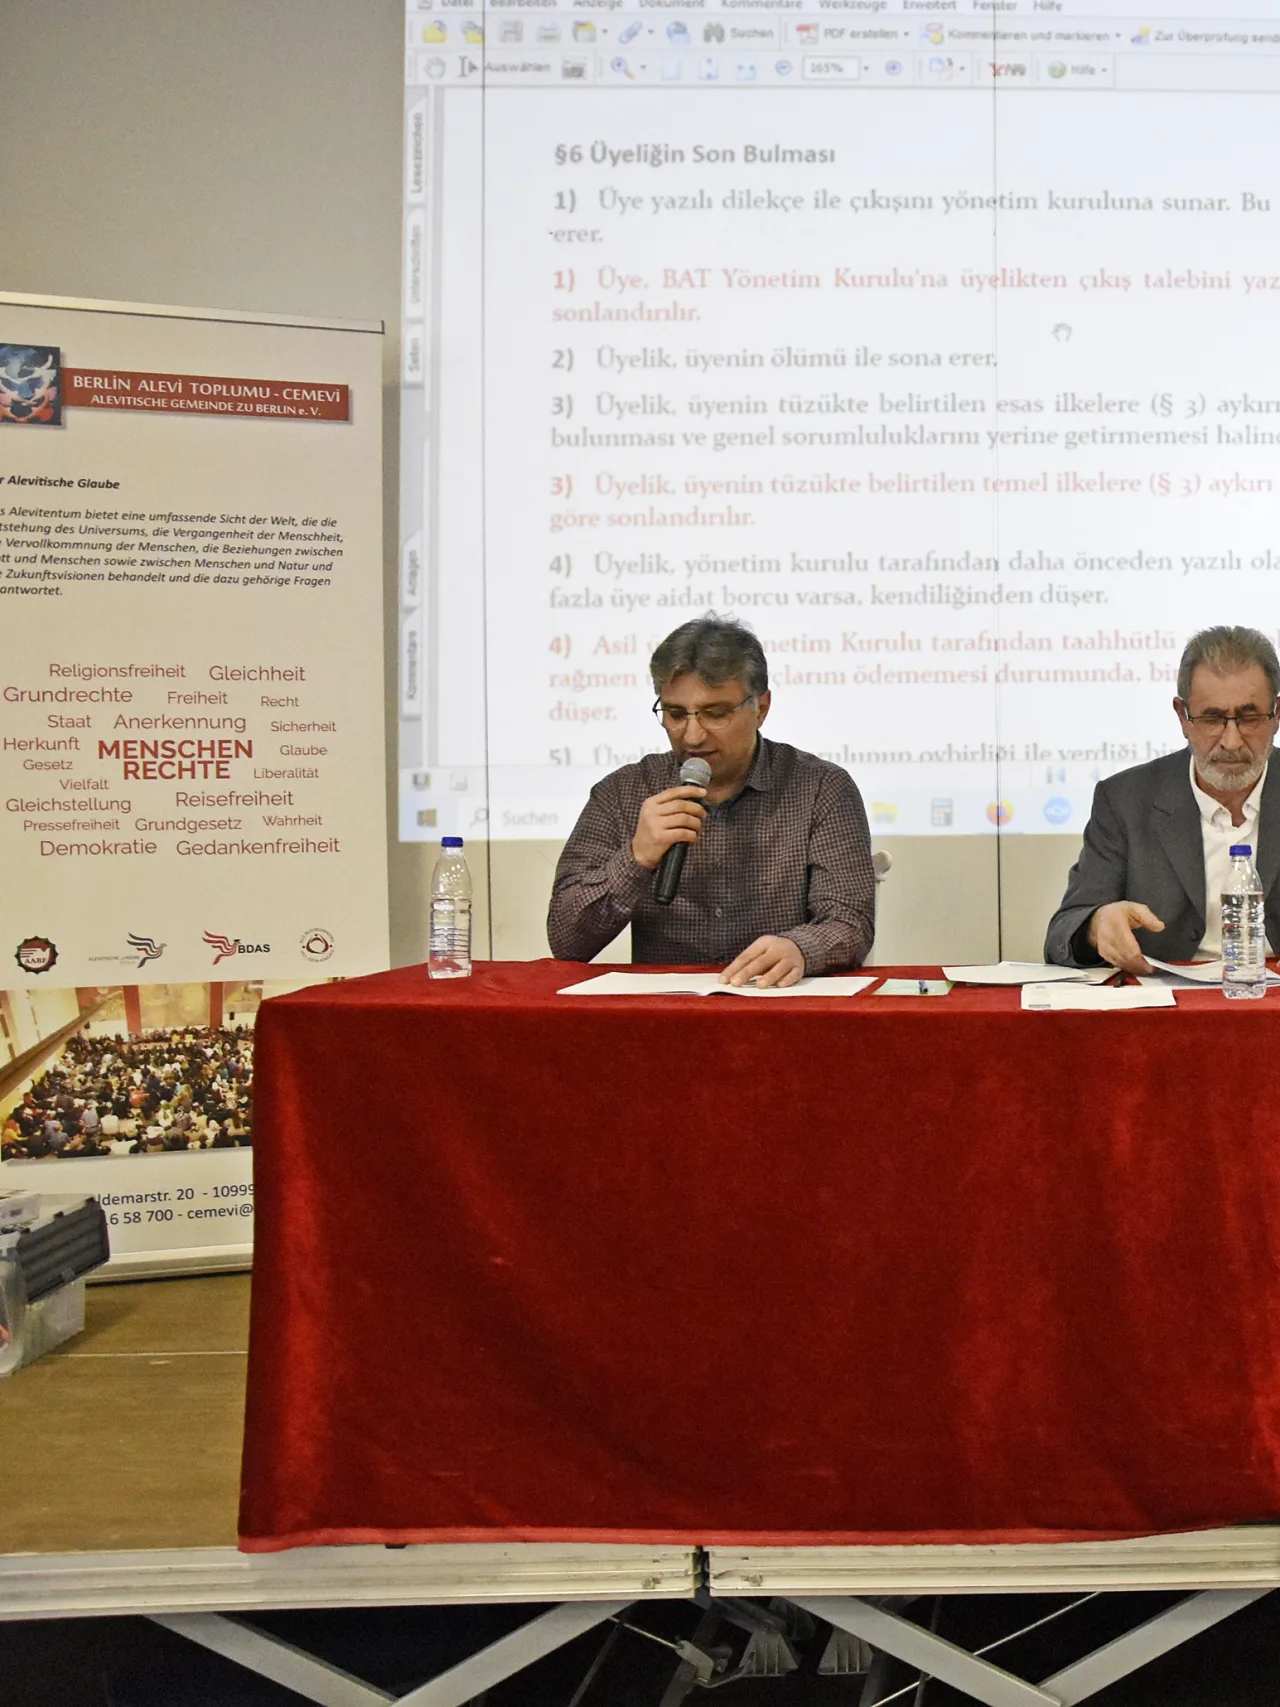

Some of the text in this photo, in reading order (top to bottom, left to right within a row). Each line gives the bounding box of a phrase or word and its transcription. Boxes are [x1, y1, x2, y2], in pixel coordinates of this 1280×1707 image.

[555, 140, 835, 168] §6 Üyeliğin Son Bulması
[554, 188, 577, 215] 1)
[599, 185, 643, 217] Üye
[650, 188, 712, 215] yazılı
[722, 188, 804, 213] dilekçe
[814, 188, 842, 210] ile
[849, 188, 933, 214] çıkışını
[941, 189, 1038, 214] yönetim
[1048, 188, 1153, 212] kuruluna
[1162, 197, 1230, 212] sunar.
[1241, 191, 1271, 212] Bu
[554, 226, 603, 242] erer.
[552, 348, 574, 374] 2)
[597, 345, 676, 374] Üyelik,
[685, 348, 764, 374] üyenin
[771, 346, 846, 368] ölümü
[855, 345, 882, 367] ile
[888, 352, 942, 367] sona
[74, 375, 130, 391] BERLİN
[138, 378, 182, 393] ALEVİ
[189, 382, 270, 399] TOPLUMU
[283, 387, 340, 403] CEMEVİ
[91, 395, 321, 416] ALEVITISCHE GEMEINDE ZU BERLIN e. V.
[7, 475, 120, 489] Alevitische Glaube
[8, 506, 337, 528] Alevitentum bietet eine umfassende Sicht der Welt, die die
[0, 522, 343, 543] tstehung des Universums, die Vergangenheit der Menschheit,
[6, 538, 343, 558] Vervollkommnung der Menschen, die Beziehungen zwischen
[49, 664, 186, 680] Religionsfreiheit
[209, 666, 306, 681] Gleichheit
[3, 687, 133, 702] Grundrechte
[168, 691, 228, 704] Freiheit
[261, 696, 299, 707] Recht
[48, 715, 91, 728] Staat
[114, 714, 246, 733] Anerkennung
[271, 721, 336, 732] Sicherheit
[4, 737, 80, 751] Herkunft
[98, 740, 253, 759] MENSCHEN
[280, 745, 328, 755] Glaube
[23, 759, 73, 770] Gesetz
[123, 761, 231, 780] RECHTE
[254, 768, 319, 778] Liberalität
[59, 779, 109, 790] Vielfalt
[6, 797, 131, 814] Gleichstellung
[176, 790, 294, 807] Reisefreiheit
[24, 819, 120, 831] Pressefreiheit
[135, 817, 242, 834] Grundgesetz
[262, 815, 322, 826] Wahrheit
[40, 838, 157, 856] Demokratie
[176, 838, 340, 855] Gedankenfreiheit
[237, 944, 270, 954] BDAS
[98, 1191, 171, 1206] ldemarstr.
[177, 1187, 194, 1201] 20
[106, 1213, 119, 1225] 6
[124, 1211, 141, 1224] 58
[146, 1208, 173, 1223] 700
